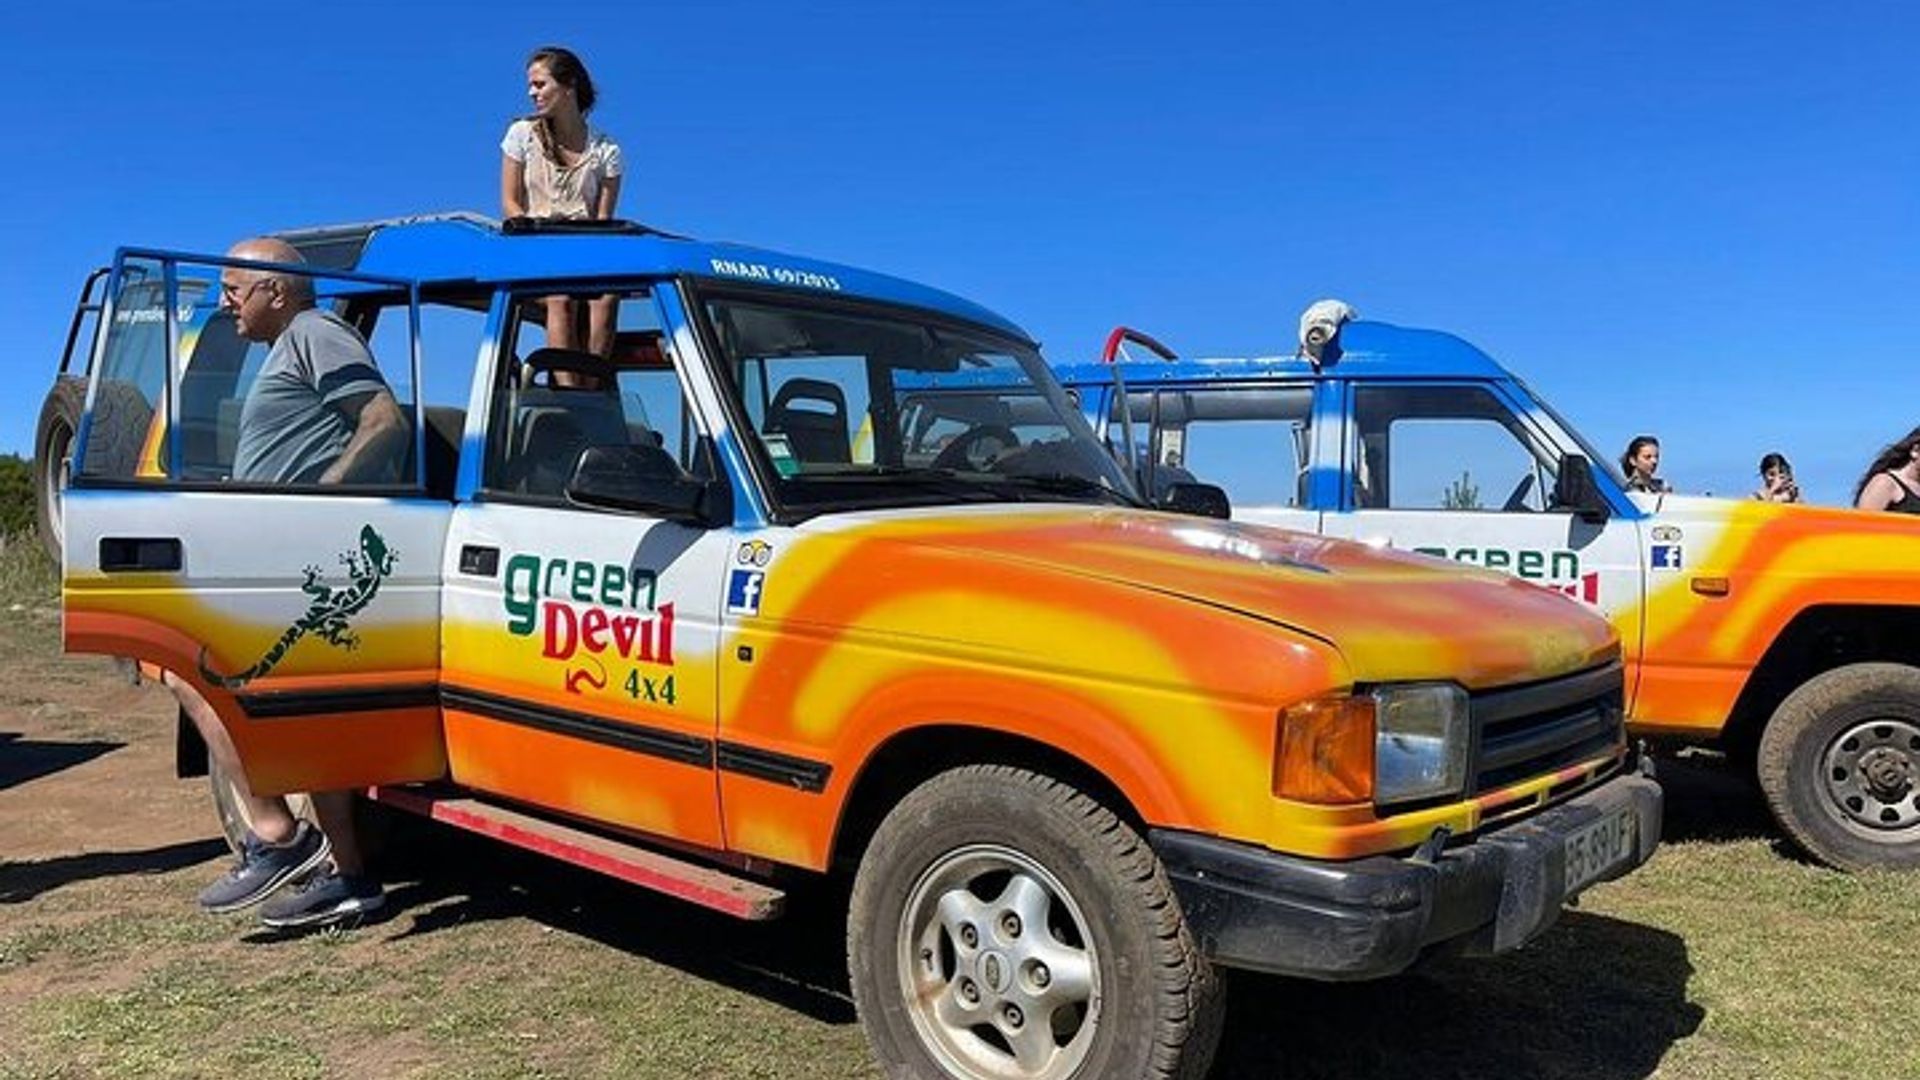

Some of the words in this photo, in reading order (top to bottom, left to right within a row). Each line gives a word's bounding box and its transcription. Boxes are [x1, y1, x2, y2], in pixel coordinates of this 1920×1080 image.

[710, 258, 770, 279] RNAAT
[1403, 548, 1578, 578] reen
[505, 554, 657, 635] green
[542, 602, 675, 666] Devil
[624, 668, 676, 705] 4x4
